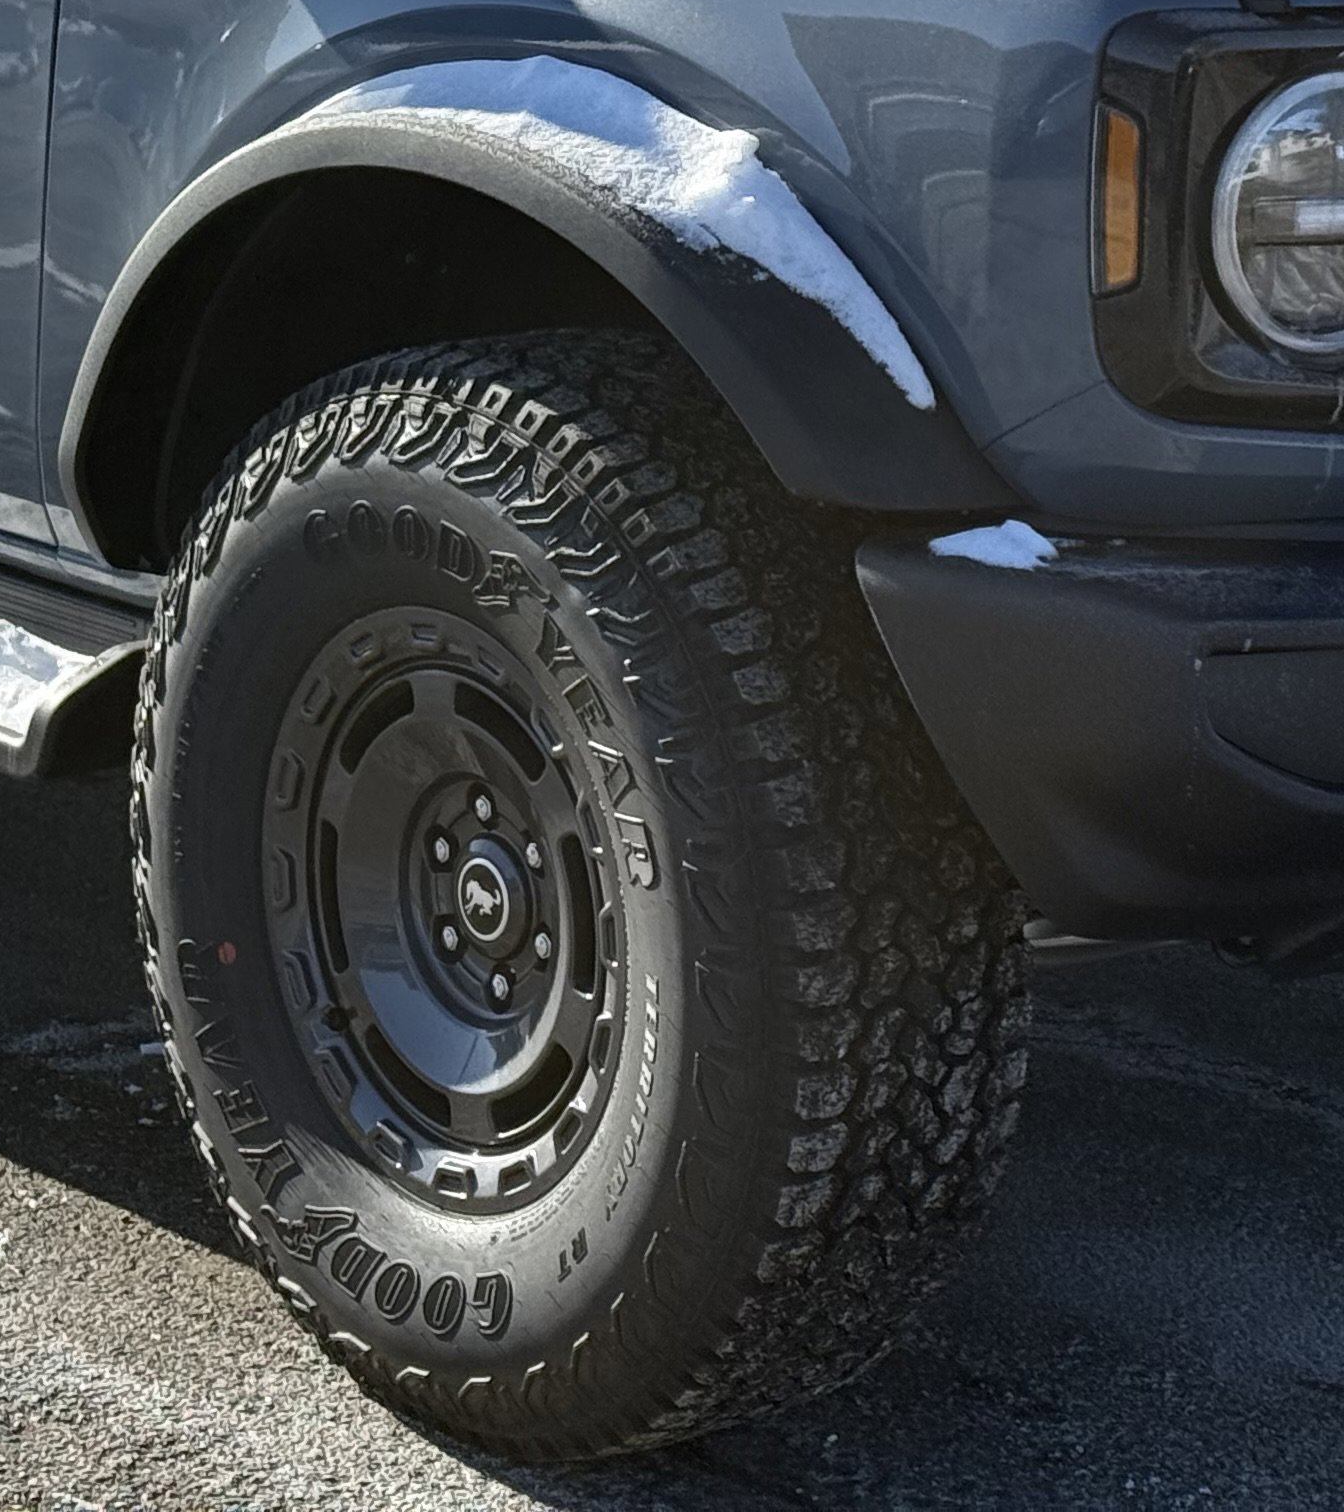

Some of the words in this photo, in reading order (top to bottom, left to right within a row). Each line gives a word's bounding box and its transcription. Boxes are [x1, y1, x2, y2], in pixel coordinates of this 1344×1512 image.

[302, 499, 659, 889] GOODYEAR
[177, 938, 516, 1338] GOODYEAR
[557, 1226, 590, 1284] RT
[605, 972, 660, 1223] TERRITORY
